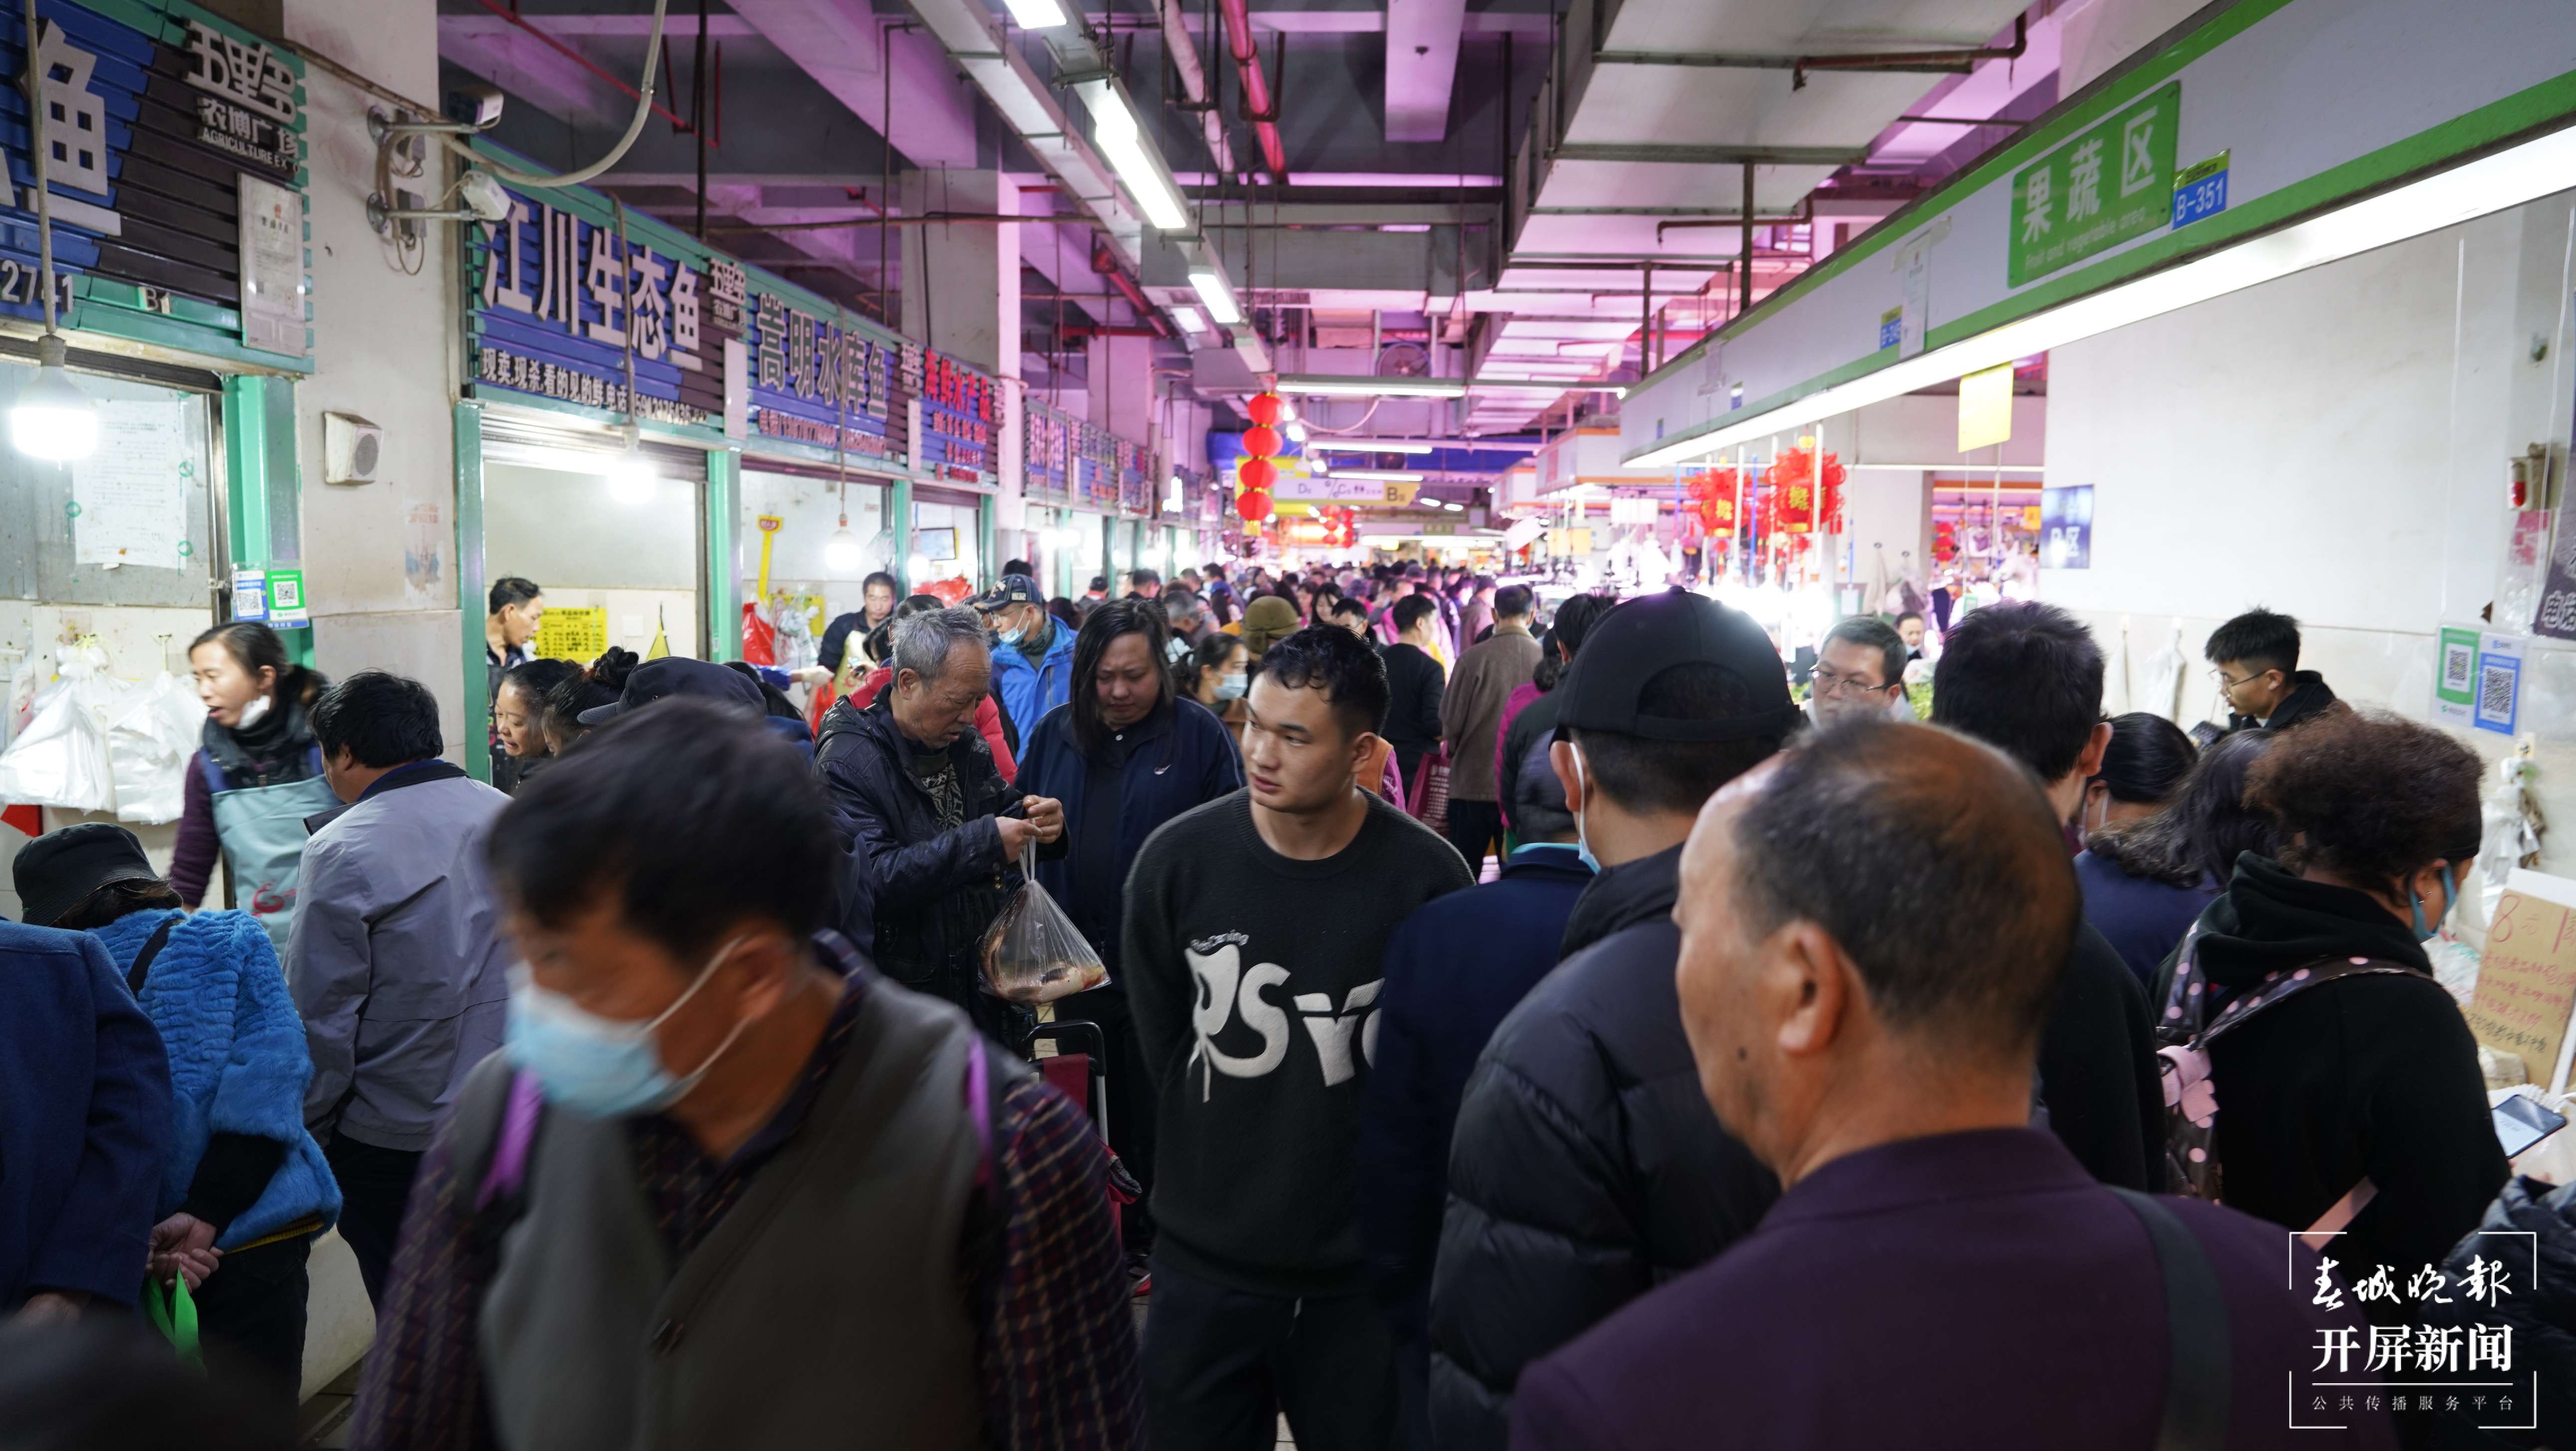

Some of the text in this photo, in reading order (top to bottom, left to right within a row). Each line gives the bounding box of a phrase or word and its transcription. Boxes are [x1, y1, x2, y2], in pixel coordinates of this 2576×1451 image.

[200, 127, 300, 172] AGRICULTURE EXO
[2022, 105, 2158, 244] 果蔬区
[2176, 177, 2224, 222] B-351
[1, 259, 74, 313] 271
[480, 200, 703, 371] 江川生态鱼
[756, 292, 888, 420] 嵩明水库鱼
